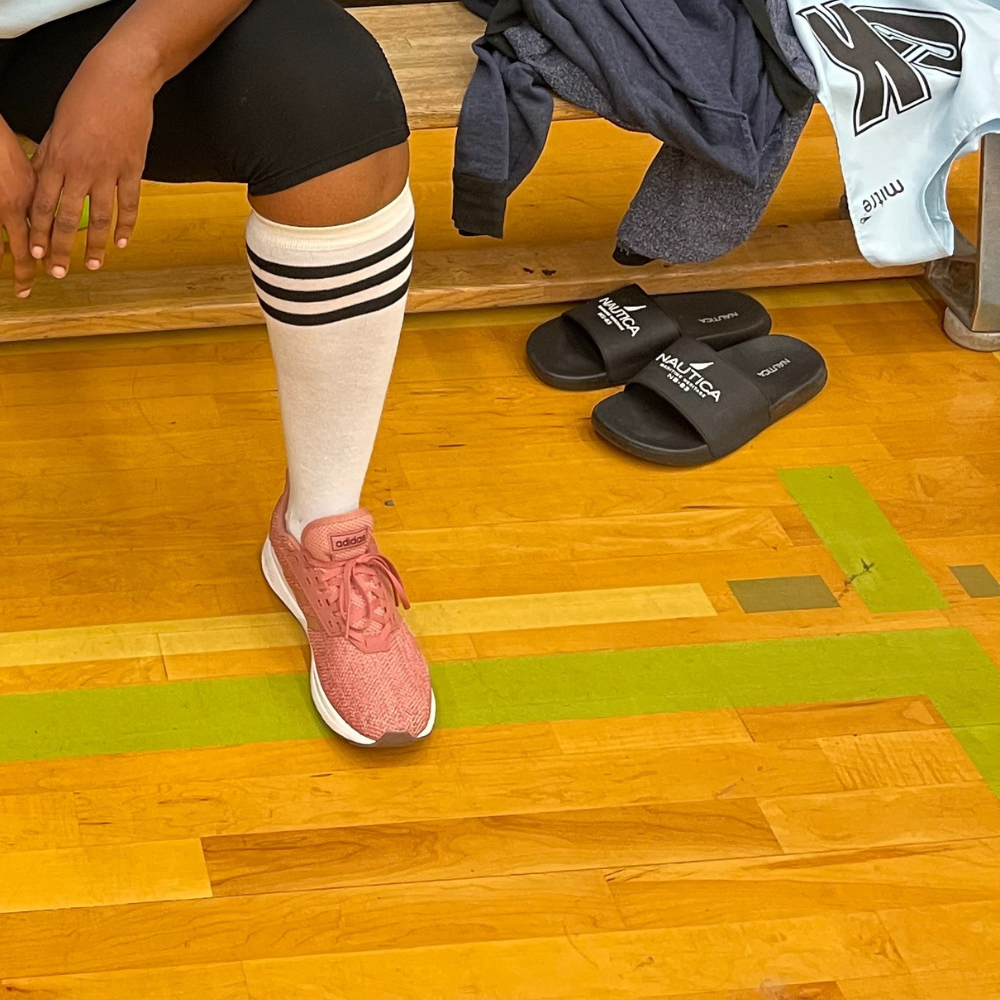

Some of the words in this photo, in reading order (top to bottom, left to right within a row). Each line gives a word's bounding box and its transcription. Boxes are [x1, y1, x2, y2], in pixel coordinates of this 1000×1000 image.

[862, 179, 905, 213] mitre
[599, 297, 640, 337] NAUTICA
[655, 353, 721, 403] NAUTICA
[757, 358, 791, 377] NAUTICA
